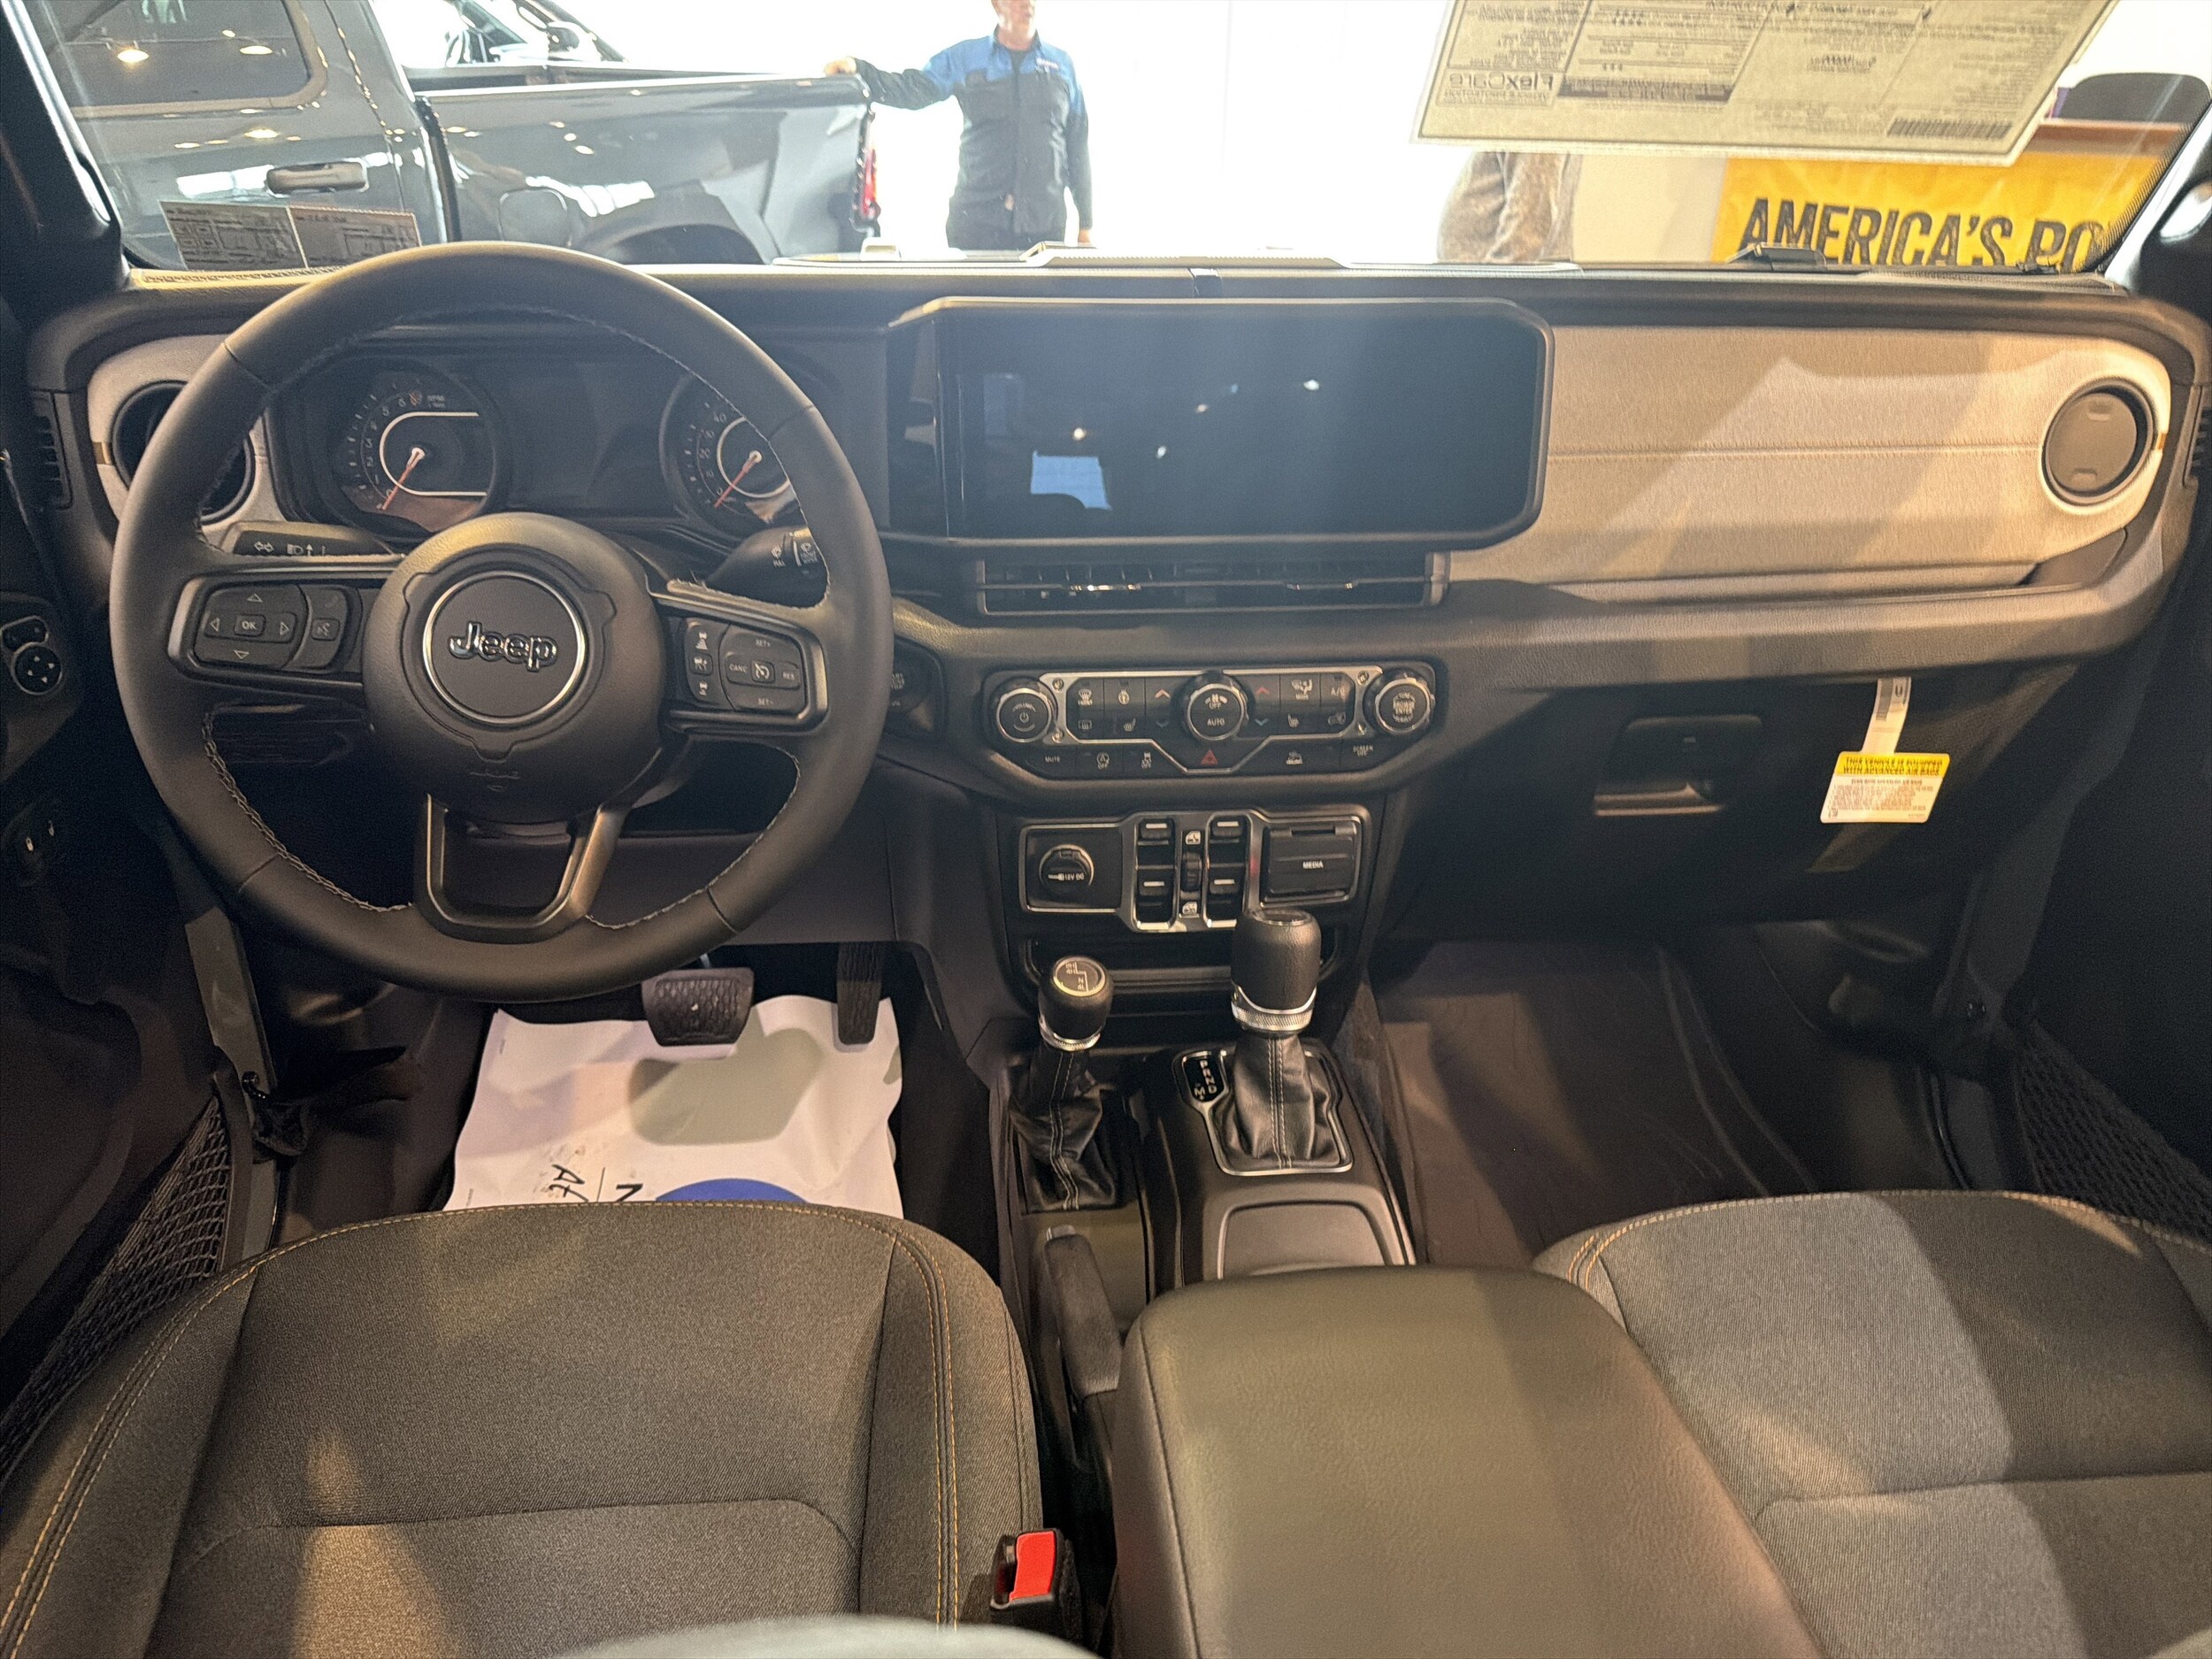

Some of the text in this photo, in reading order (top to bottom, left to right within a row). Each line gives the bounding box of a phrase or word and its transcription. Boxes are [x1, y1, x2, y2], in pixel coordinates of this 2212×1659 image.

[1737, 197, 2013, 265] AMERICA'S
[242, 620, 257, 630] OK
[448, 621, 558, 672] Jeep
[783, 671, 795, 680] RES
[1302, 860, 1324, 870] MEDIA
